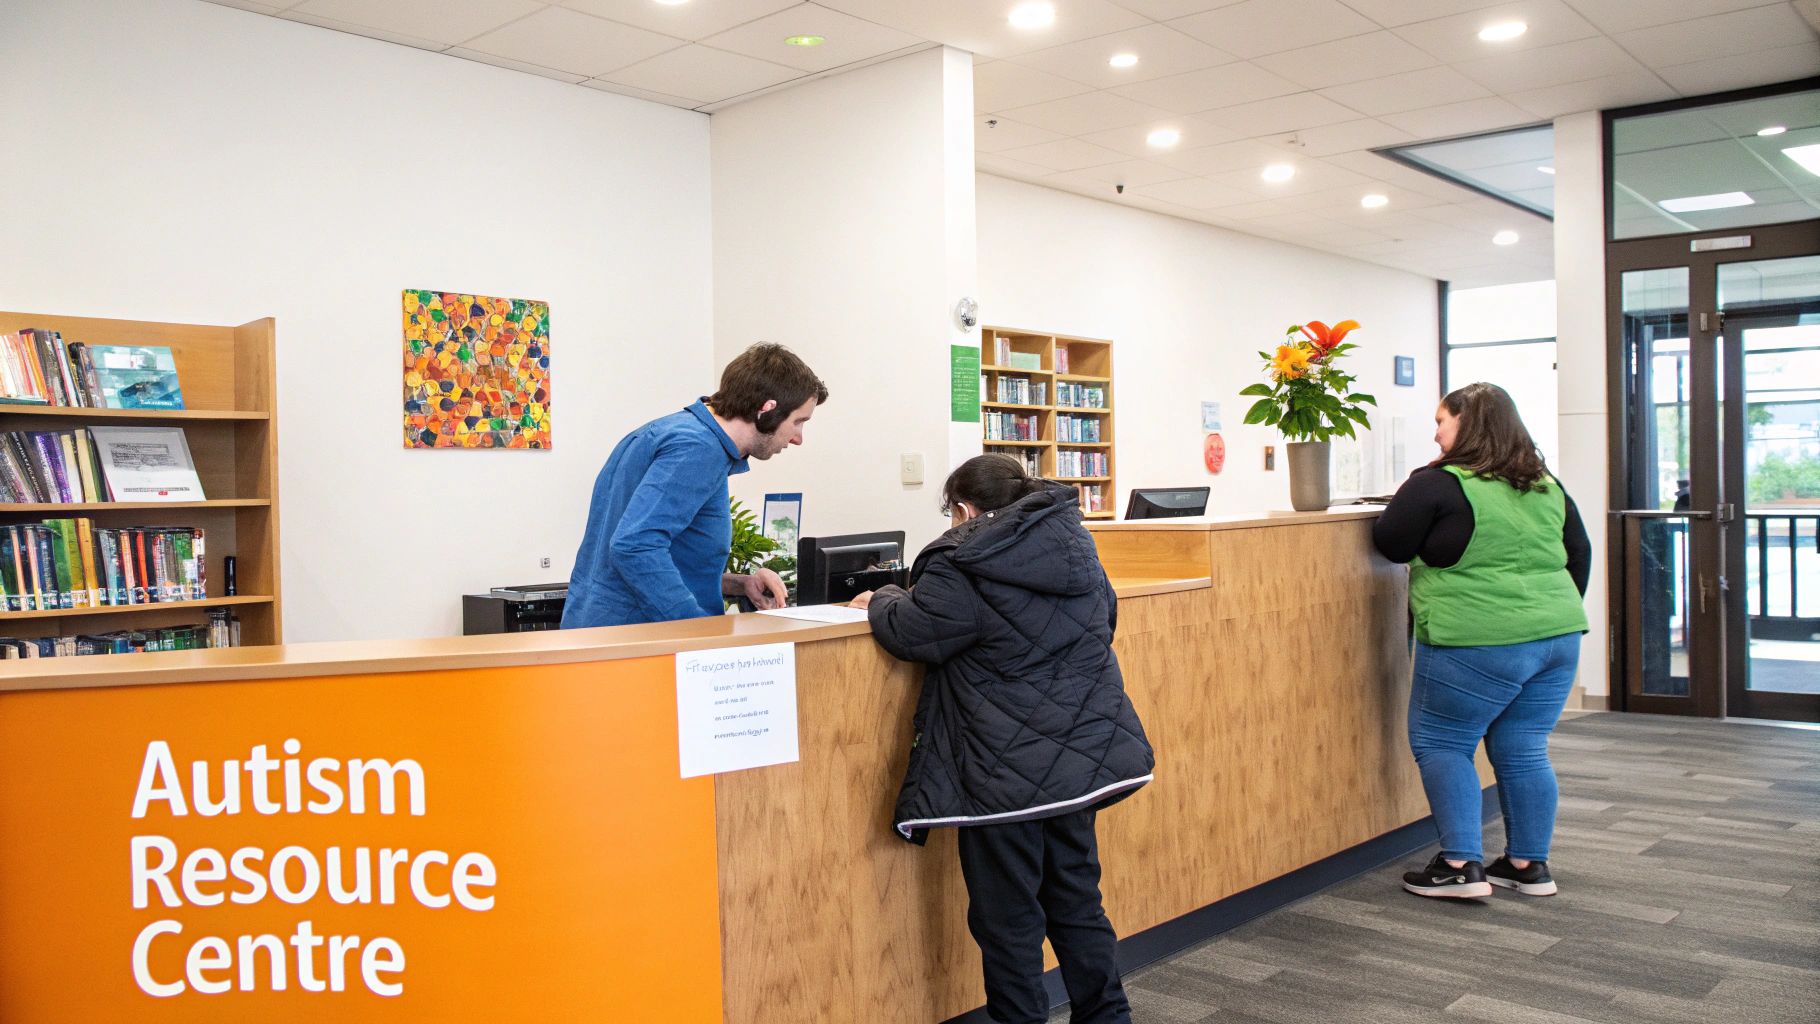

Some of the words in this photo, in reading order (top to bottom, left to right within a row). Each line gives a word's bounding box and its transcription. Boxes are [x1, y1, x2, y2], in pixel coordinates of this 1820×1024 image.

[131, 738, 425, 818] Autism
[130, 835, 496, 911] Resource
[132, 919, 405, 998] Centre
